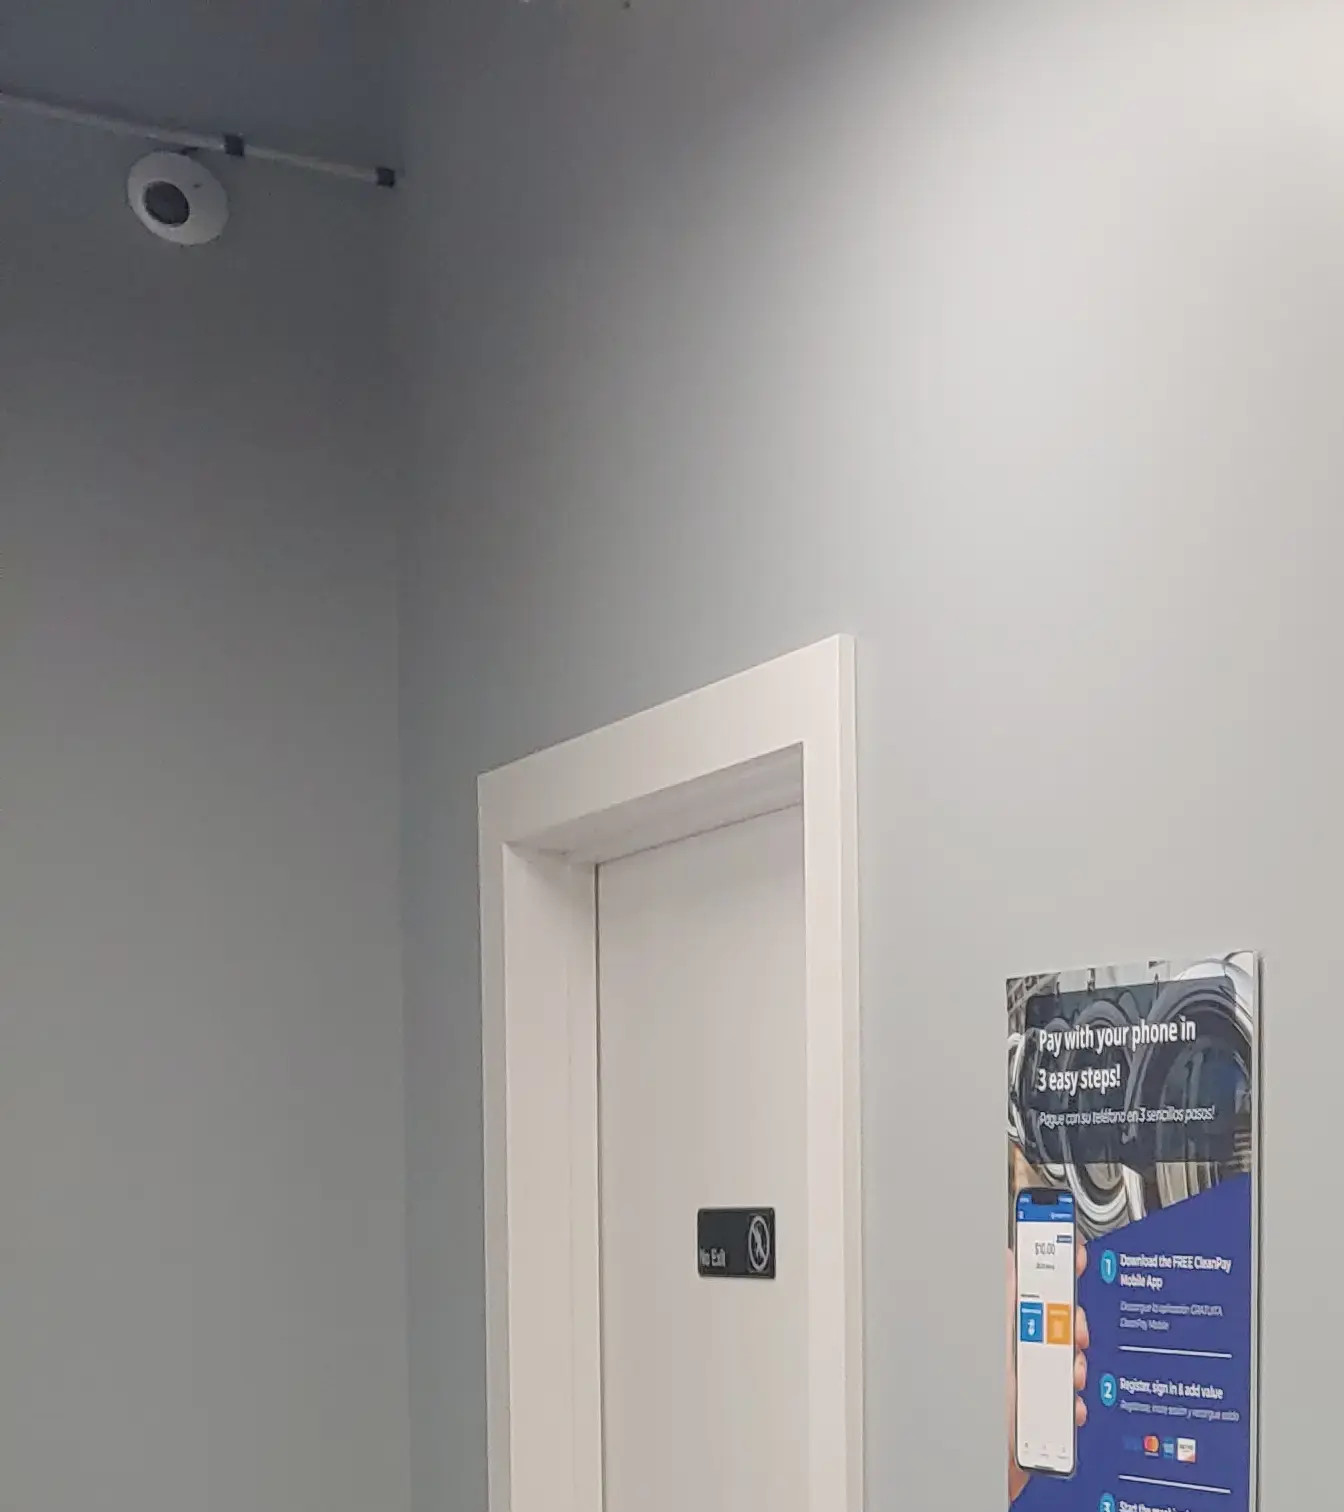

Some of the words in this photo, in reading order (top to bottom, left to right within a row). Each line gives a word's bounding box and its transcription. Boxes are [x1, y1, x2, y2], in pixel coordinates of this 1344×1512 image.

[1039, 1030, 1062, 1057] Pay
[1064, 1024, 1093, 1050] with
[1096, 1025, 1130, 1052] your
[1132, 1019, 1178, 1050] phone
[1180, 1015, 1196, 1040] in
[1038, 1068, 1047, 1090] 3
[1050, 1071, 1077, 1095] easy
[1080, 1064, 1121, 1094] steps!
[1120, 1254, 1157, 1267] Download
[1159, 1255, 1171, 1268] the
[1172, 1256, 1193, 1269] FREE
[1194, 1256, 1231, 1274] CleanPay
[1120, 1274, 1145, 1287] Mobile
[1147, 1275, 1162, 1291] App
[1152, 1380, 1168, 1396] sign
[1169, 1381, 1177, 1395] in
[1185, 1384, 1200, 1397] add
[1201, 1386, 1223, 1399] value
